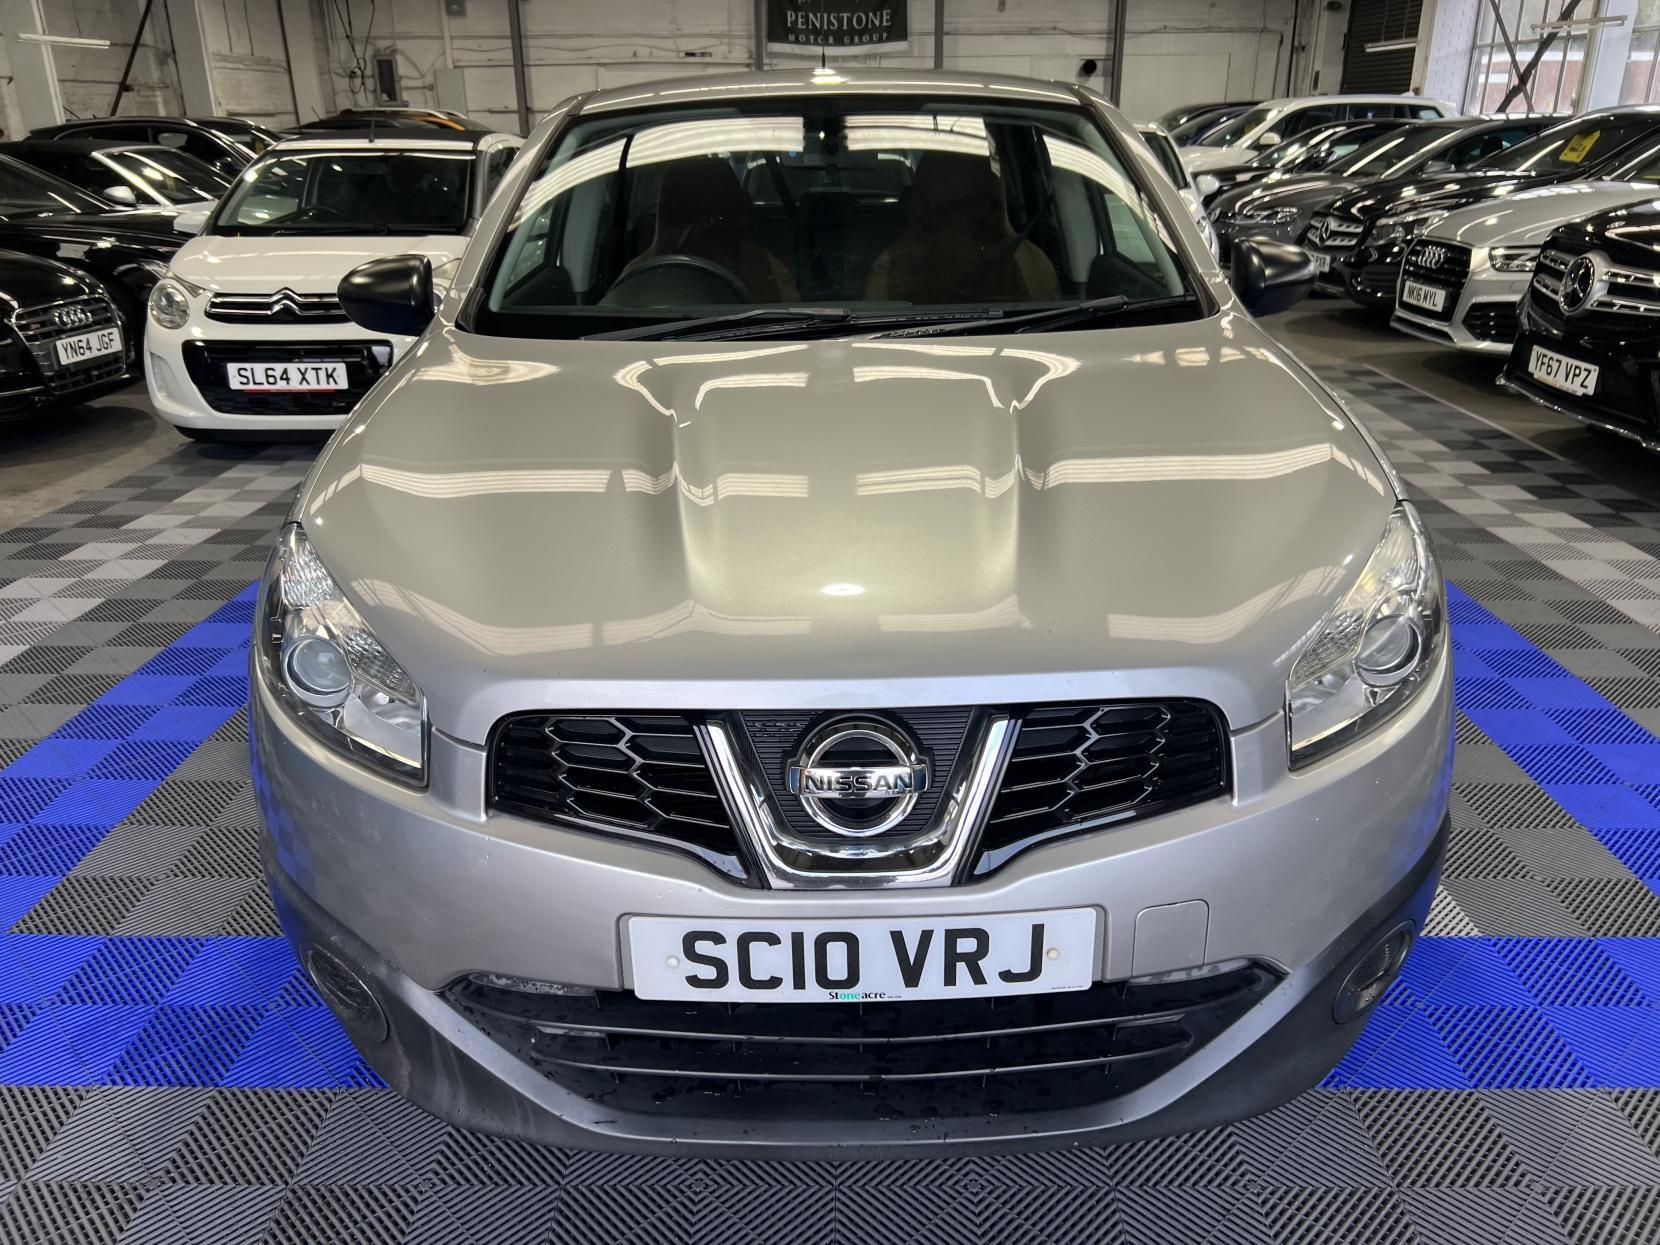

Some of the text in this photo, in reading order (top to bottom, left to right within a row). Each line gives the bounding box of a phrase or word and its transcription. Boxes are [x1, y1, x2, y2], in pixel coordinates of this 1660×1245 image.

[786, 9, 892, 30] PENISTONE
[788, 32, 888, 44] MOTOR GROUP
[1406, 284, 1437, 307] NK16 MYL
[61, 332, 114, 360] YN64 JGF
[237, 367, 338, 385] SL64 XTK
[1534, 349, 1592, 389] YF67 VPZ
[804, 773, 913, 793] NISSAN
[682, 923, 1045, 990] SC10 VRJ
[828, 990, 886, 1000] Stoneacre
